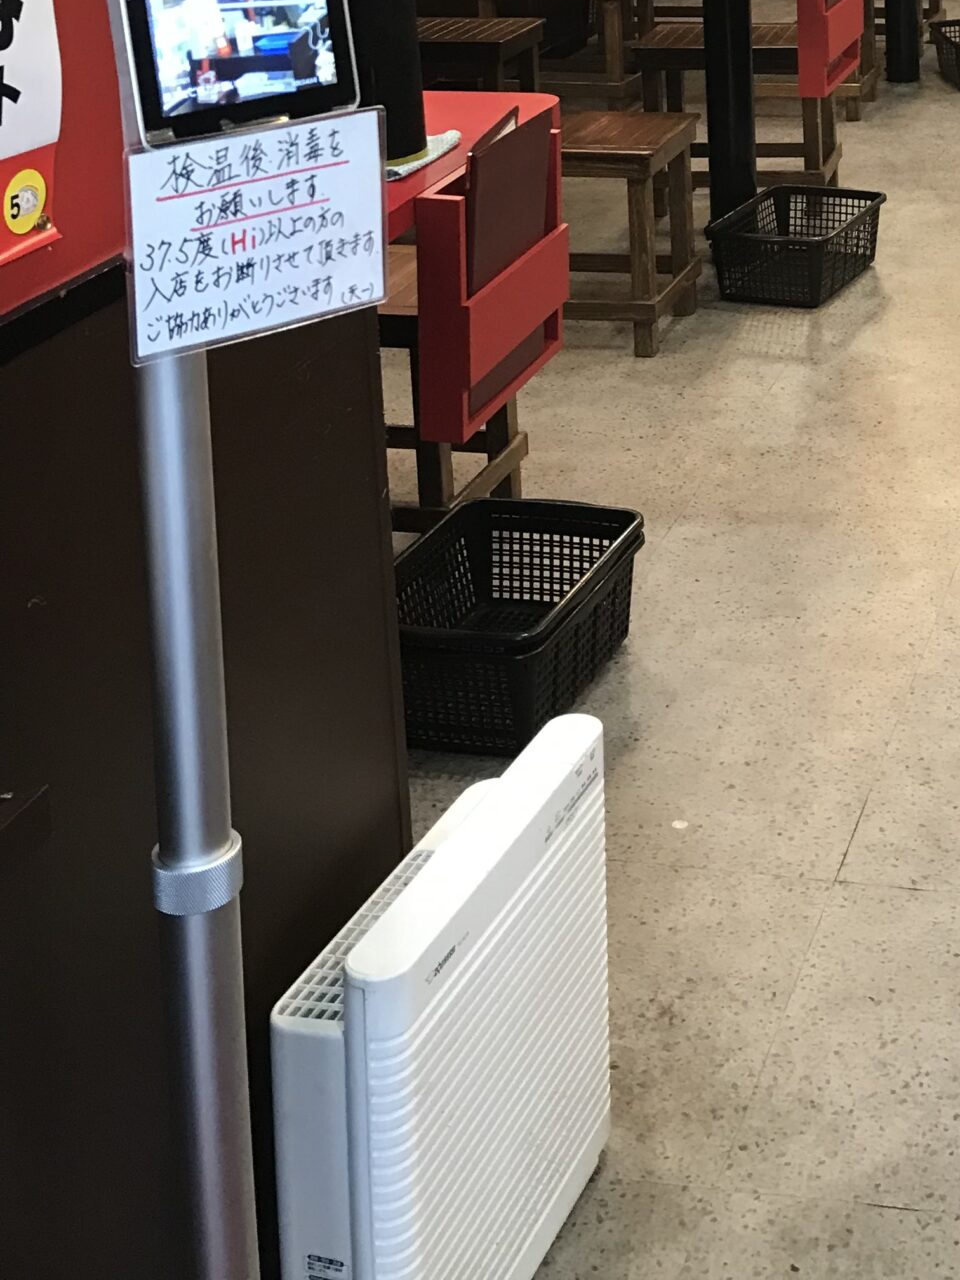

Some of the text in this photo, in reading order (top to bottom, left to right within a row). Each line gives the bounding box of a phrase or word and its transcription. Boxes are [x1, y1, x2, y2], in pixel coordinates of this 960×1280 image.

[146, 276, 334, 343] ご協力ありがとうございます
